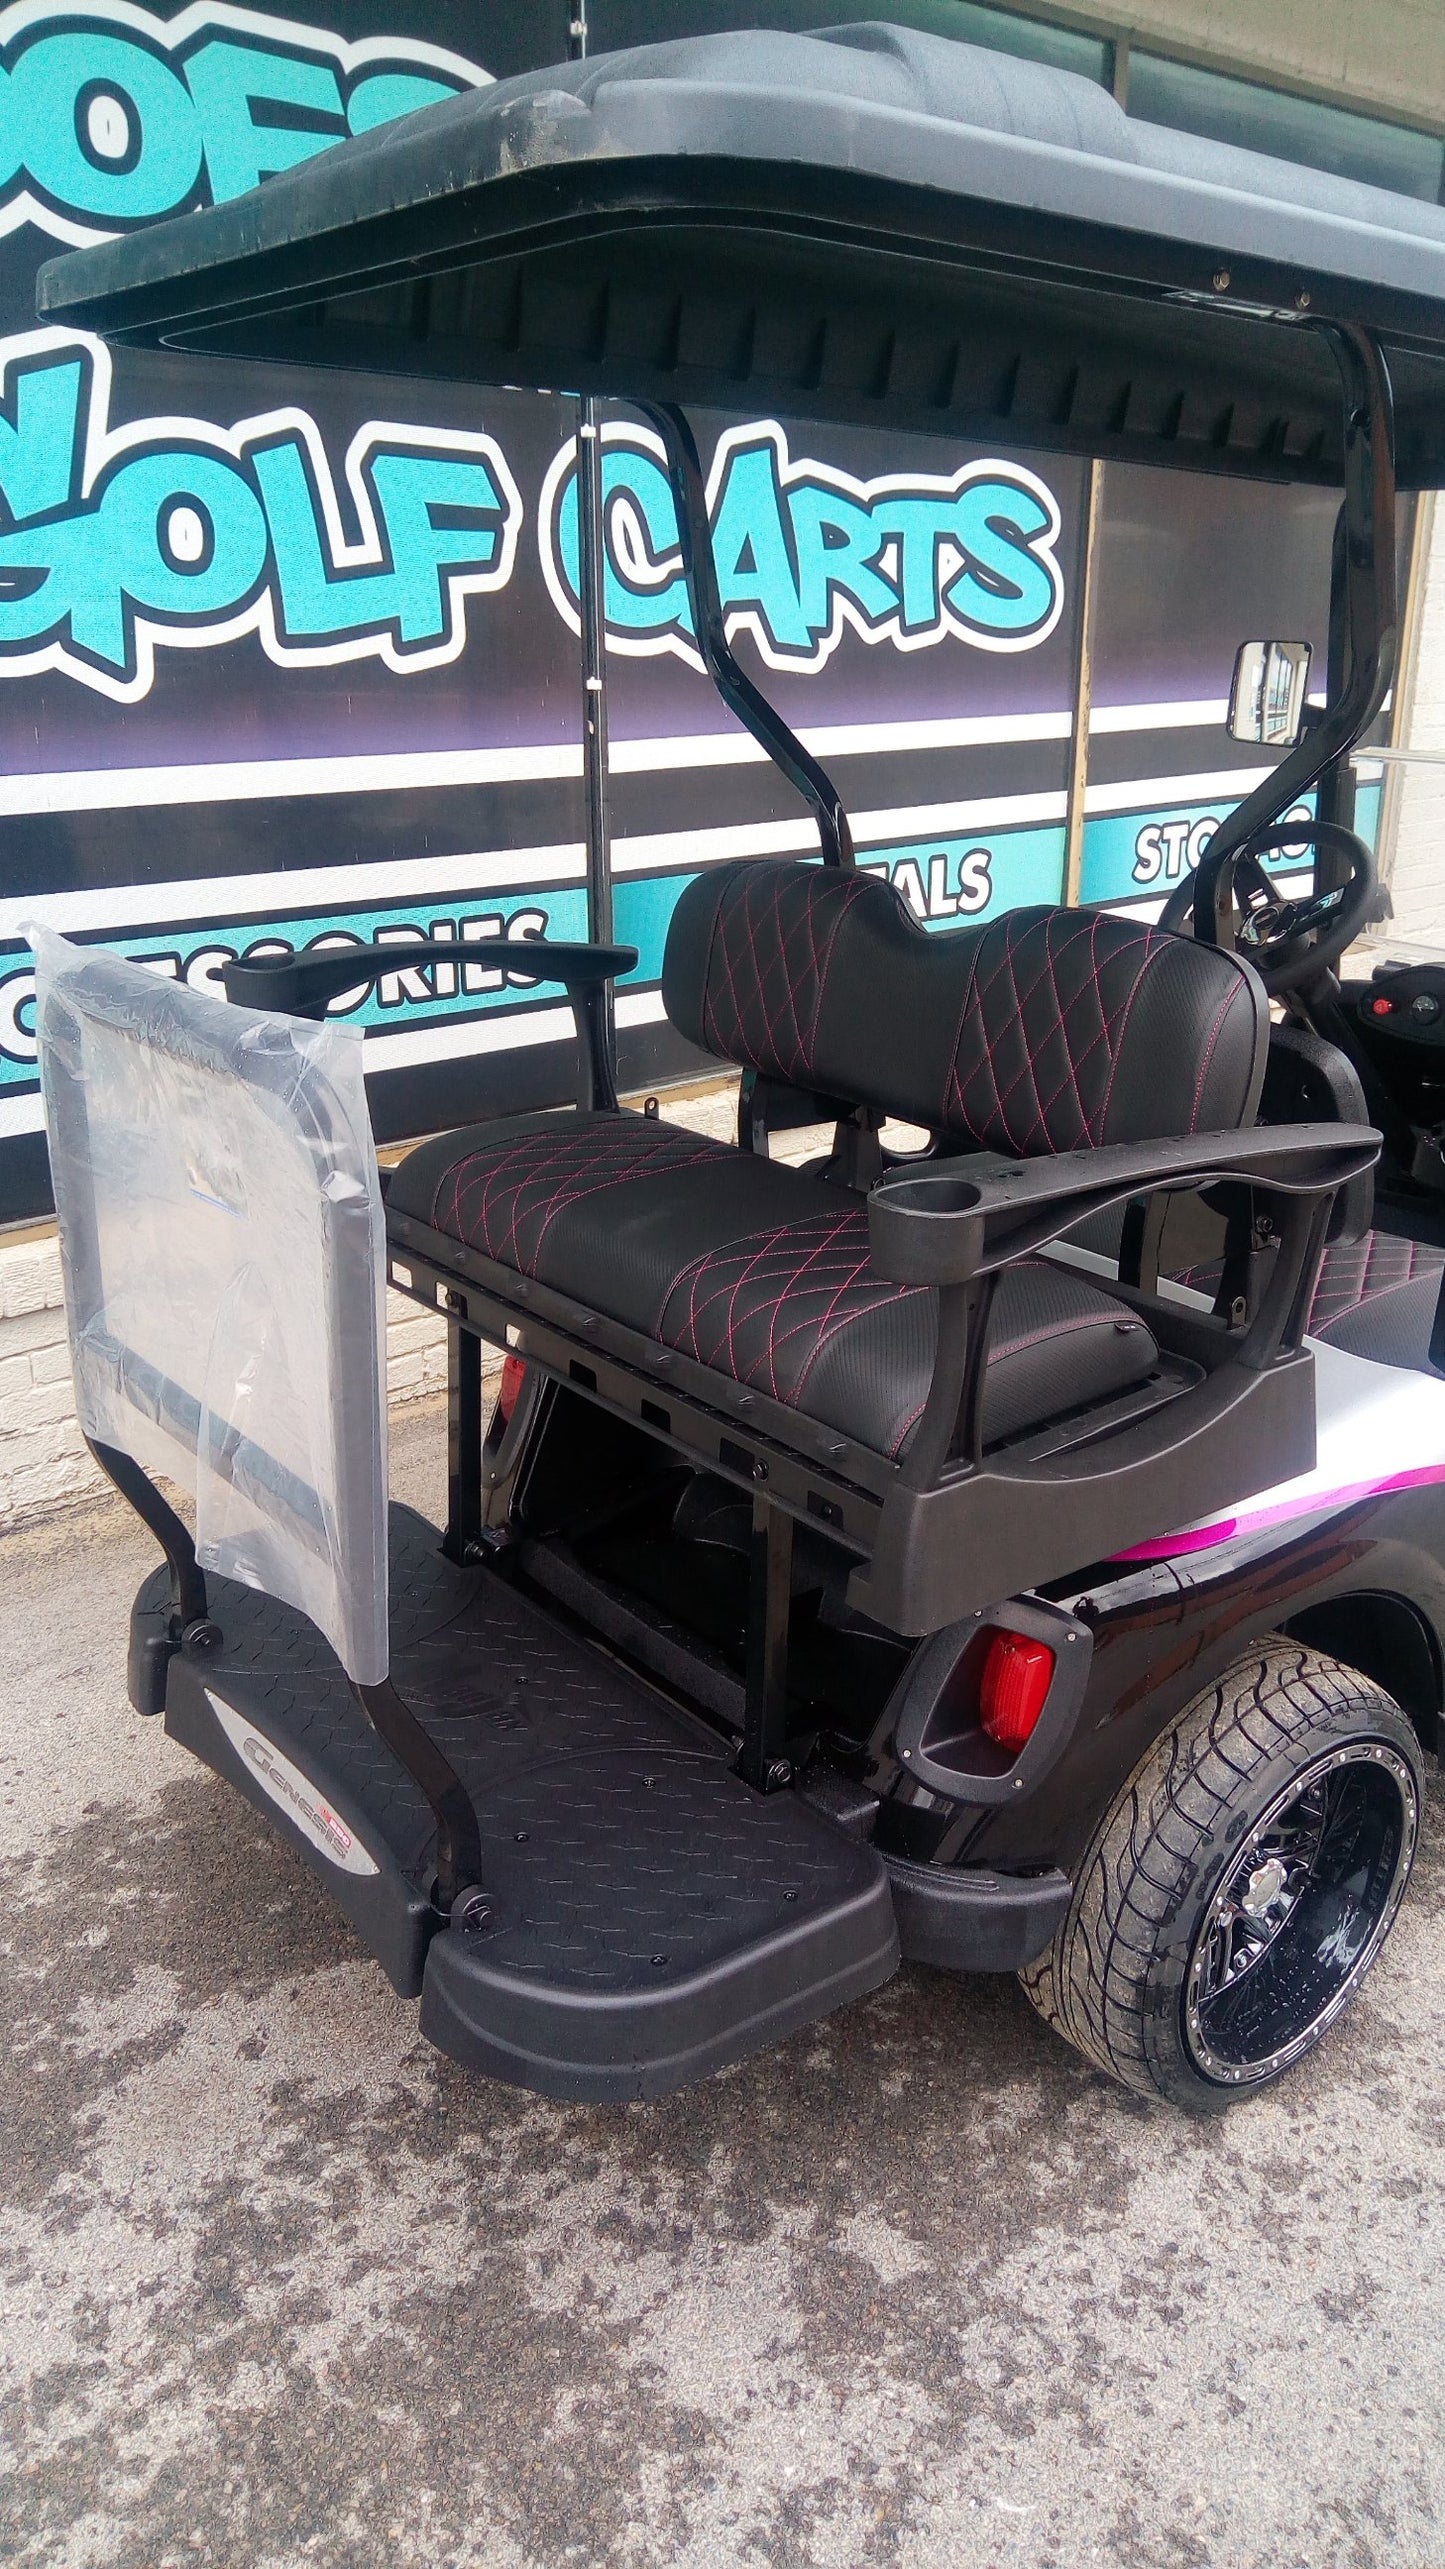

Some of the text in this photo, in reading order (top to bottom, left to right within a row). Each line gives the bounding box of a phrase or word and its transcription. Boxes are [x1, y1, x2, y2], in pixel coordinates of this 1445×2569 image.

[550, 436, 1058, 658] CARTS
[858, 849, 992, 922] ALS
[243, 1736, 348, 1861] GENESIS
